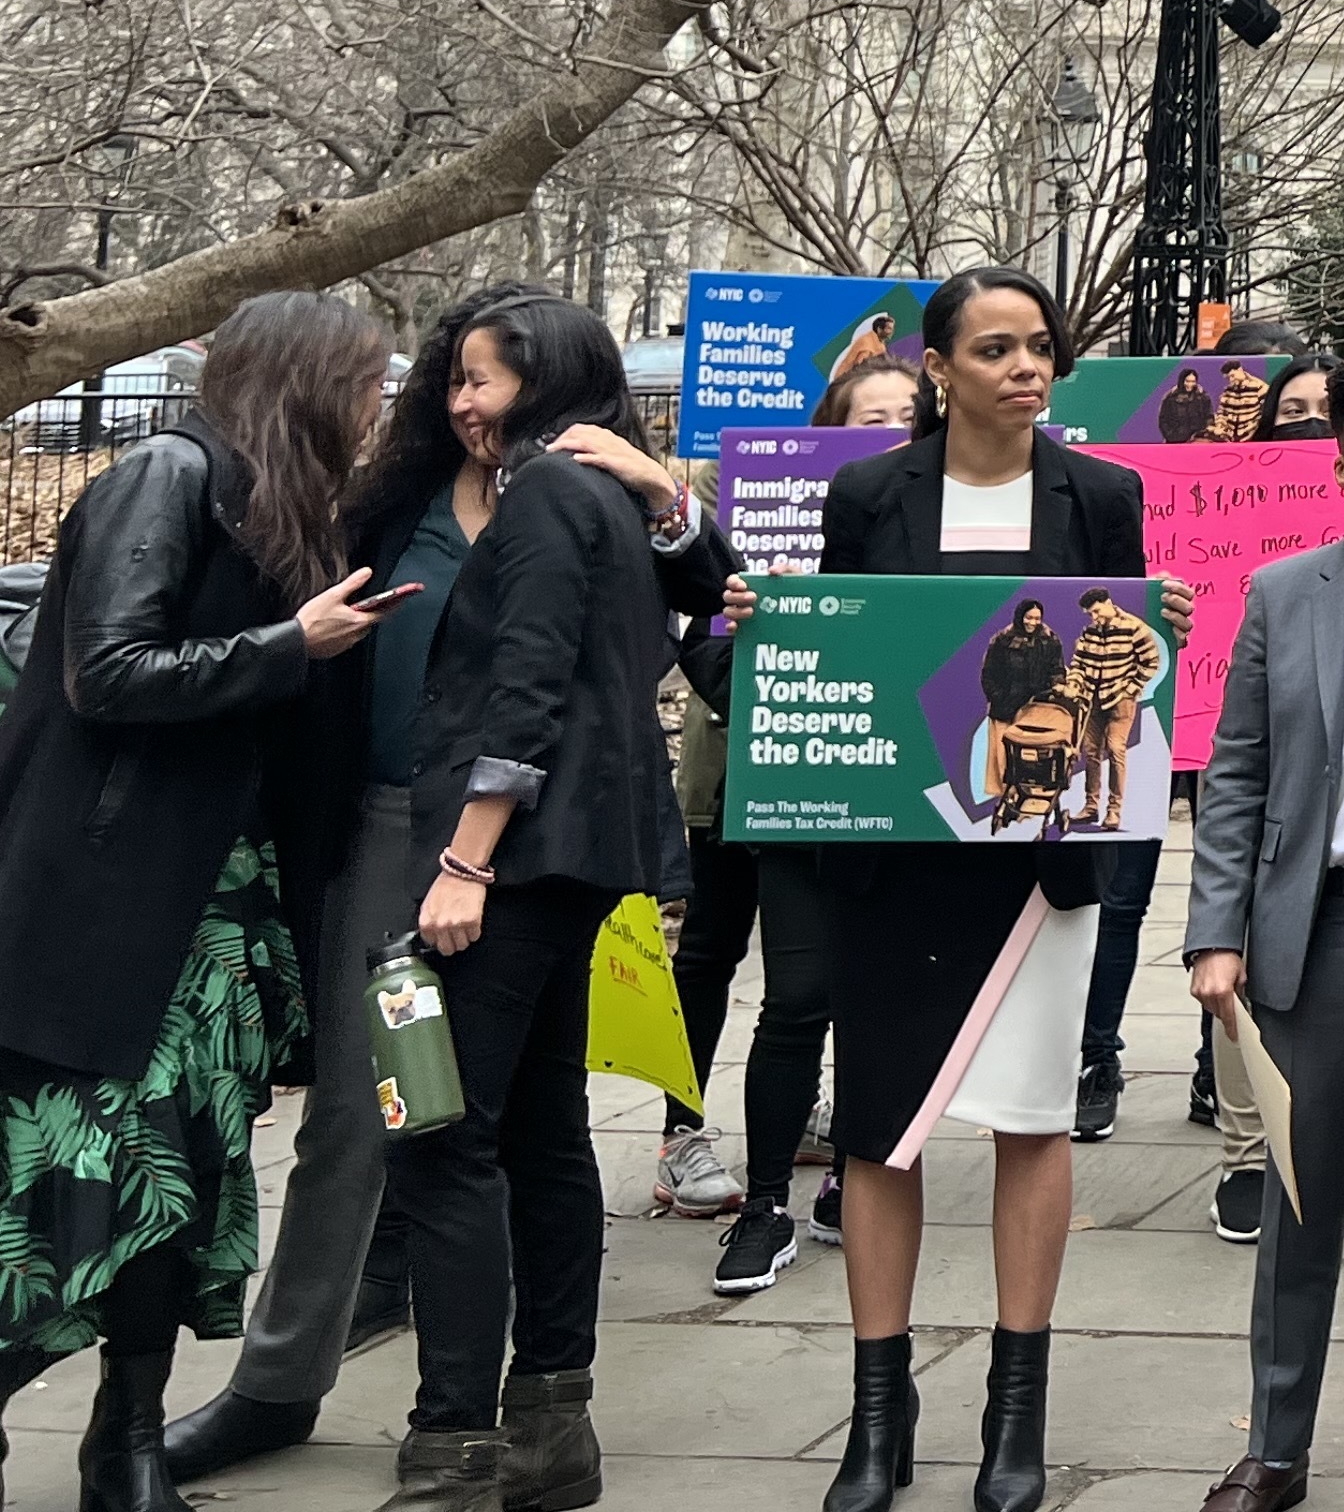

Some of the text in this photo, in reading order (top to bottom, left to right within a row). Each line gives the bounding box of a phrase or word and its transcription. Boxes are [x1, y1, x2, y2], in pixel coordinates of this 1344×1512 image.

[719, 288, 744, 302] NYIC
[702, 321, 794, 349] Working
[700, 343, 786, 365] Families
[698, 366, 786, 387] Deserve
[697, 387, 804, 410] the Credit
[751, 440, 777, 455] NYIC
[733, 476, 829, 503] Immigra
[1278, 483, 1328, 502] more
[731, 505, 823, 528] Families
[731, 531, 825, 552] Deserve
[1189, 538, 1242, 563] Save
[1261, 533, 1307, 554] more
[743, 553, 768, 574] he
[779, 597, 812, 614] NYIC
[755, 644, 819, 671] New
[755, 675, 874, 703] Yorkers
[752, 706, 872, 734] Deserve
[750, 736, 897, 765] the Credit
[747, 801, 849, 816] Pass The Working
[746, 817, 893, 831] Families Tax Credit (WFTC)
[608, 955, 643, 988] FAIR
